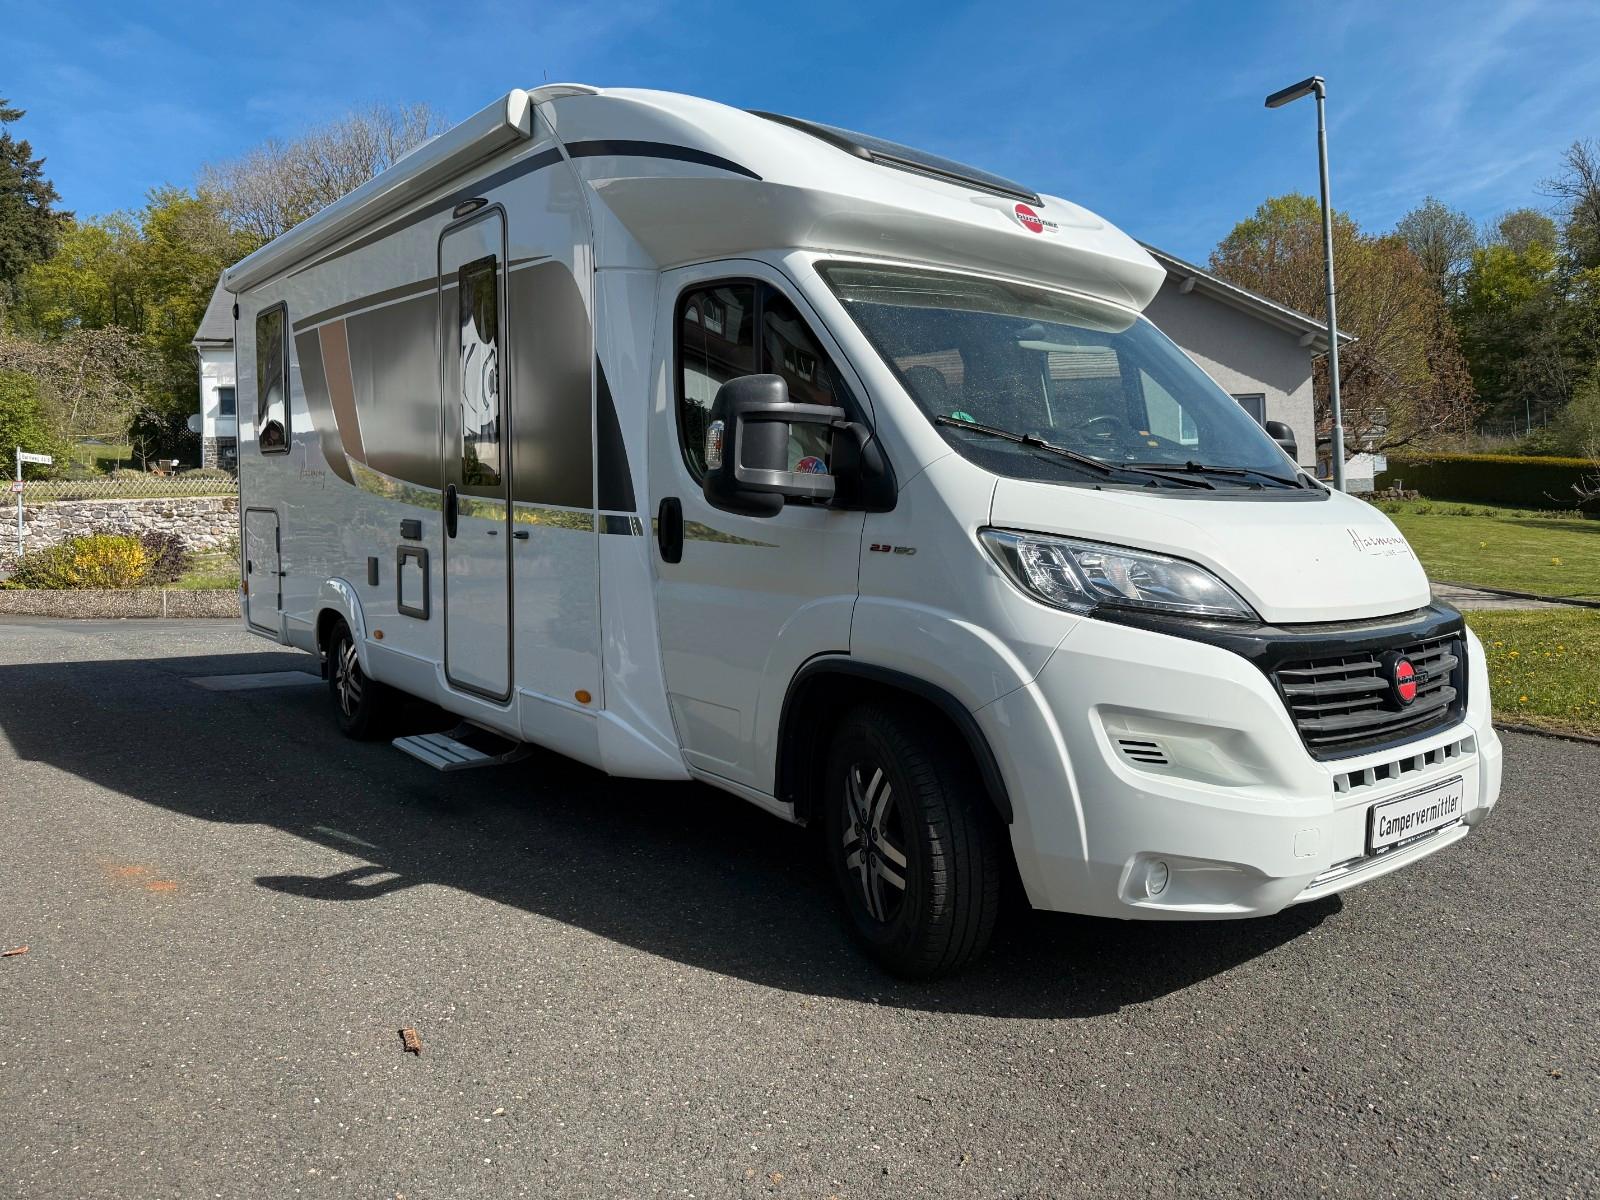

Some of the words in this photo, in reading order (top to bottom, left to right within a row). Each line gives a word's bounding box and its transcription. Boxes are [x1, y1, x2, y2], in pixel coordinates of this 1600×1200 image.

[870, 544, 892, 553] 2.3
[1346, 528, 1415, 560] Harmony
[1379, 795, 1458, 838] Campervermittler
